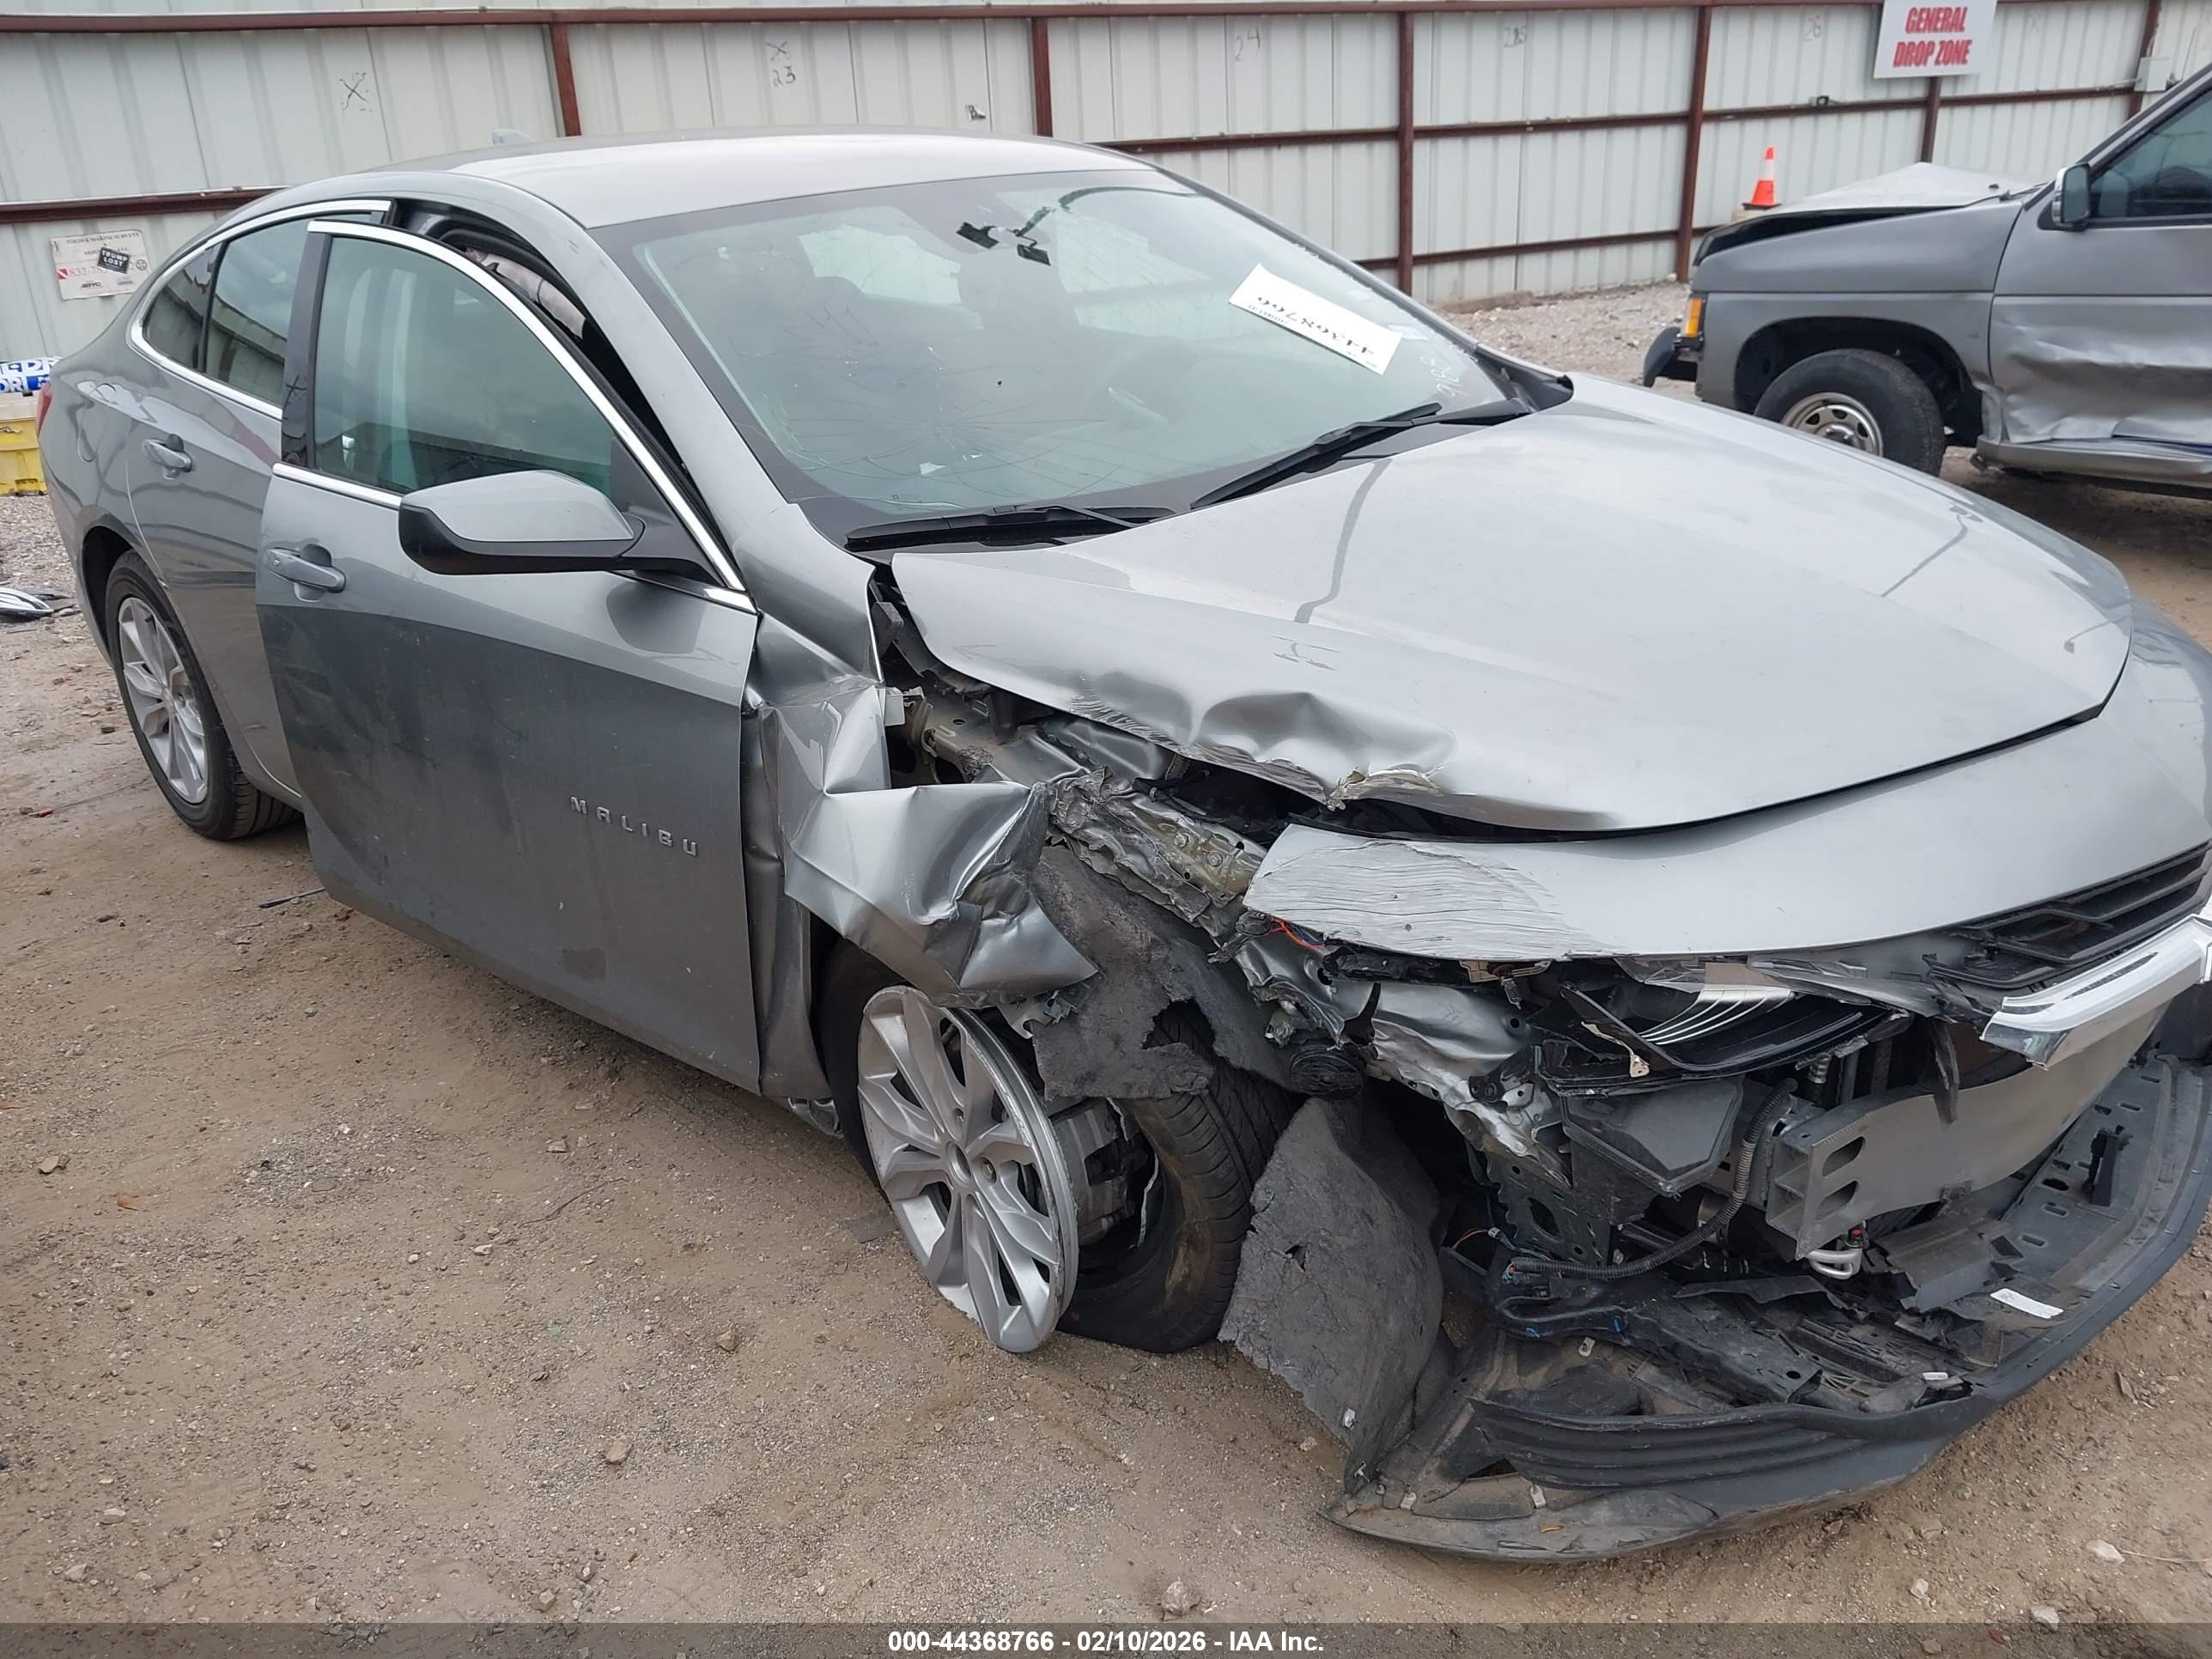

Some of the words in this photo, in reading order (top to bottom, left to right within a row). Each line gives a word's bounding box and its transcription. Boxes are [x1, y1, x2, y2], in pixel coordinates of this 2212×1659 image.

[1905, 6, 1968, 33] GENERAL
[1893, 40, 1936, 68] DROP
[1934, 40, 1972, 66] ZONE
[101, 249, 128, 261] TRUMP
[103, 257, 125, 266] LOST
[1257, 296, 1375, 355] 44368766
[570, 795, 697, 857] MALIBU
